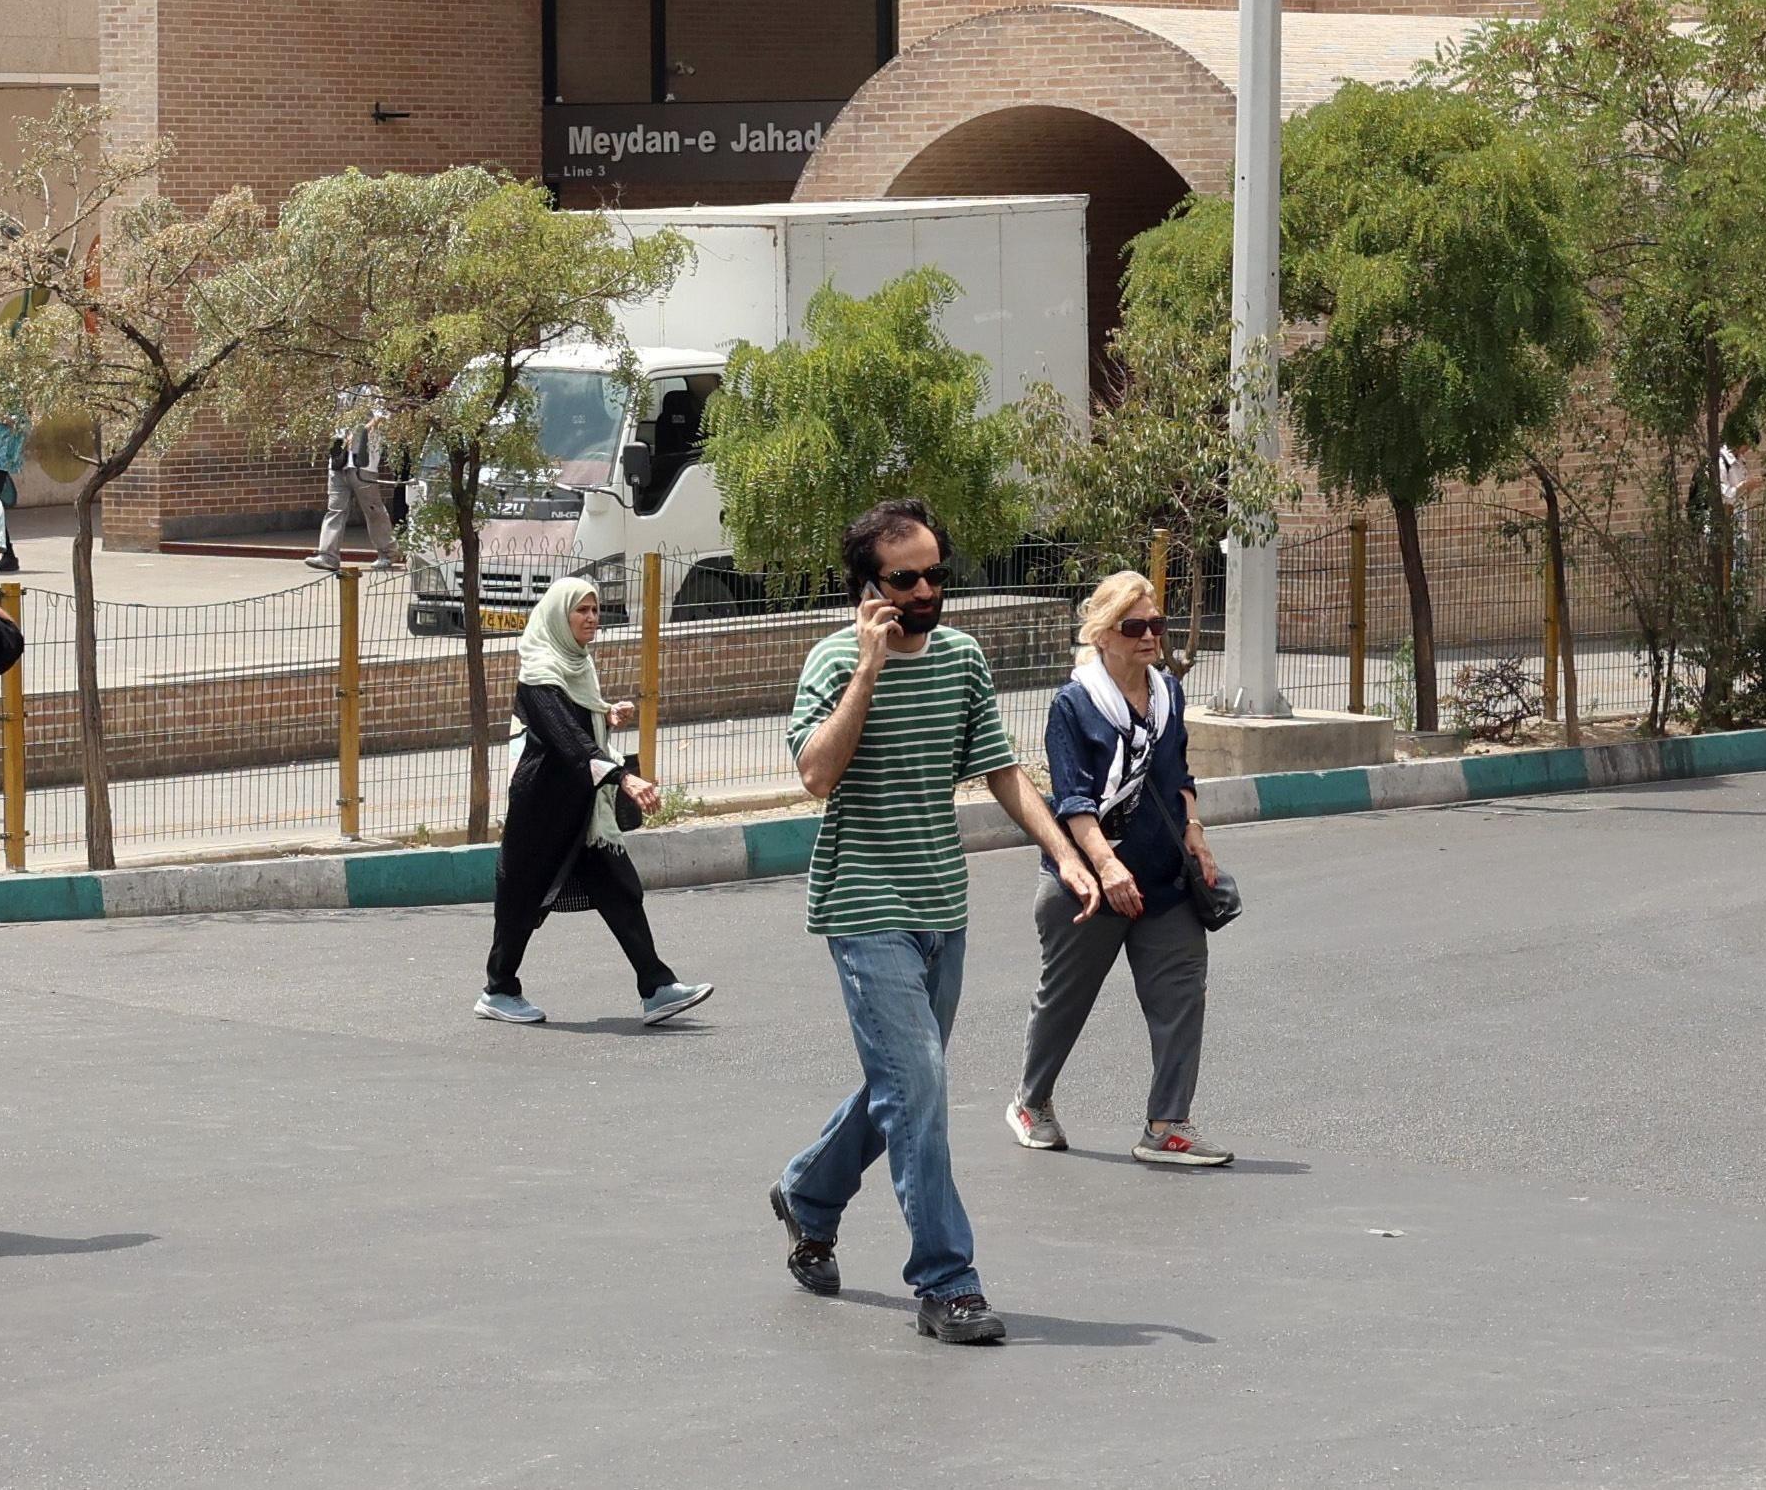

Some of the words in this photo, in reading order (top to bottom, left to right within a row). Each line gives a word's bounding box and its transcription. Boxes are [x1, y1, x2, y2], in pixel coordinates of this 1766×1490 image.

[568, 126, 717, 162] Meydan-e
[730, 122, 822, 154] Jahad
[563, 166, 594, 177] Line
[598, 166, 606, 177] 3
[550, 510, 580, 519] NKR
